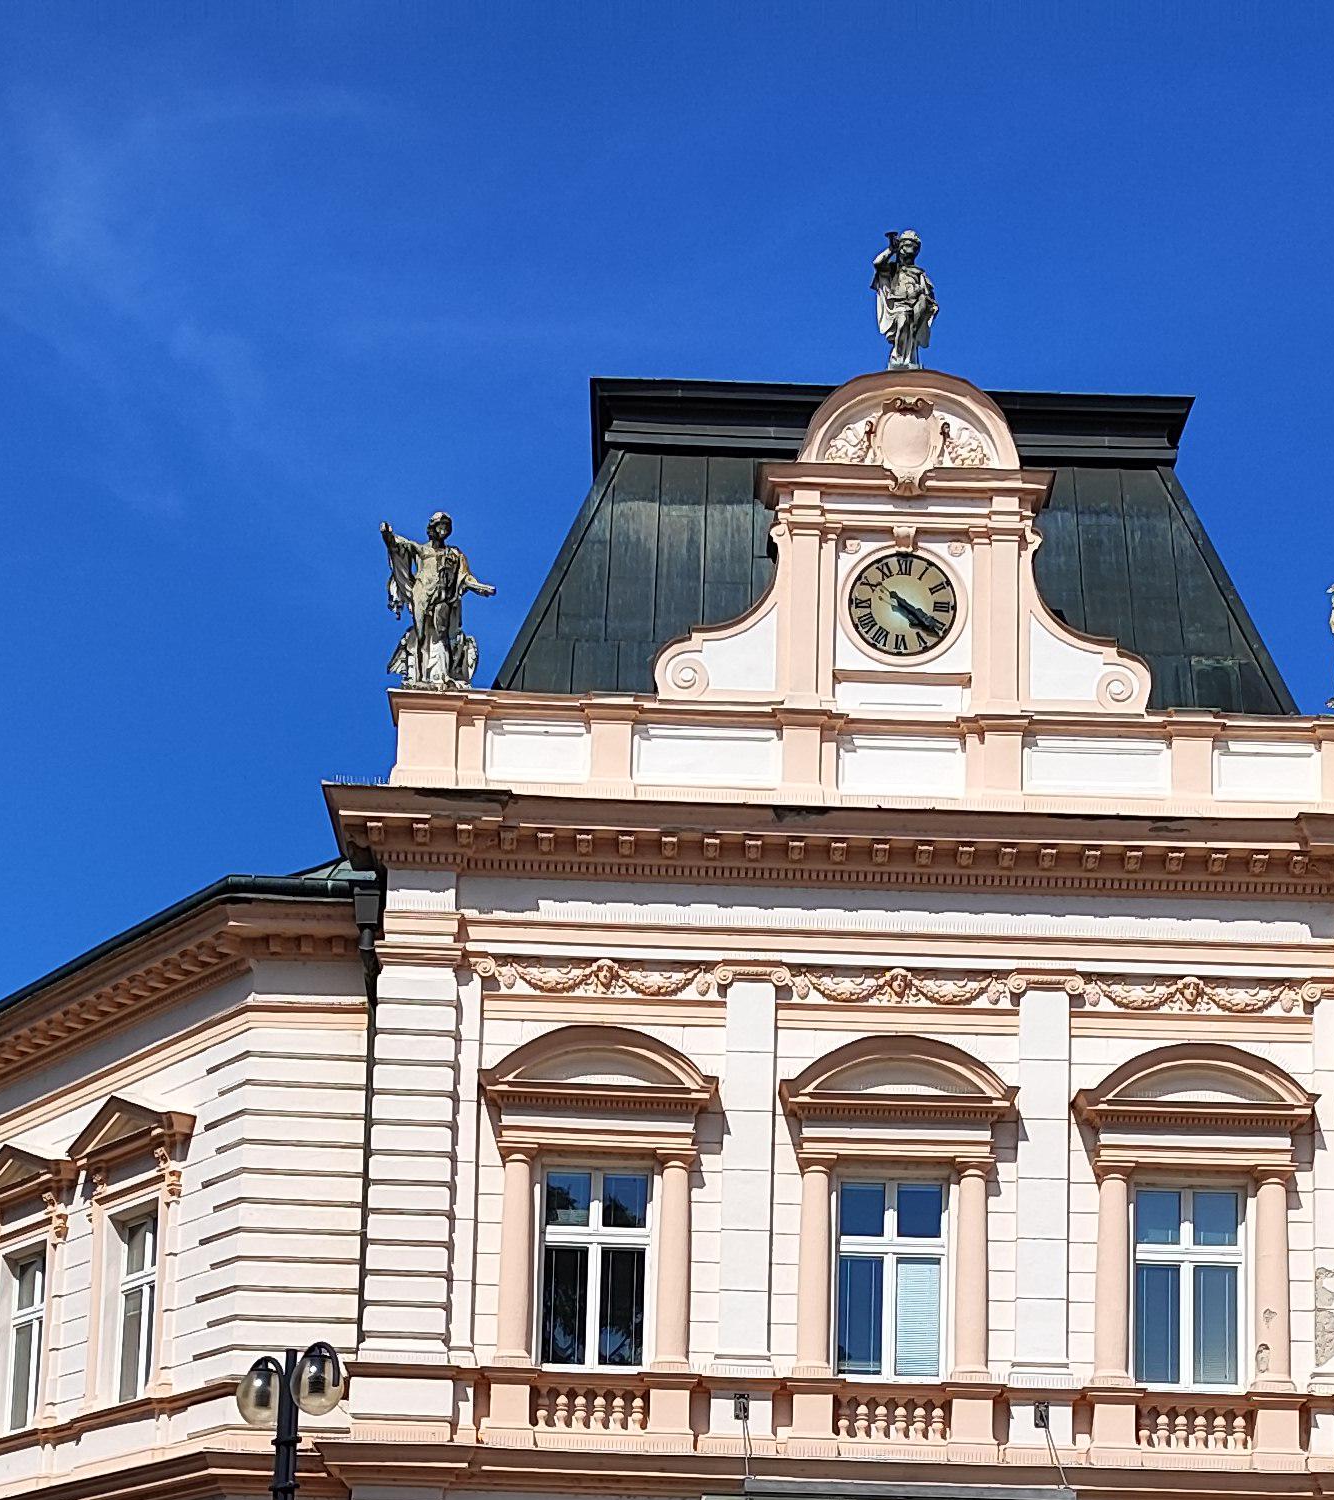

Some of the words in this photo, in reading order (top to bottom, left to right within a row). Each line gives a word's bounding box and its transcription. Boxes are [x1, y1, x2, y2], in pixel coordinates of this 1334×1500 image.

[875, 562, 894, 581] XI
[895, 558, 913, 576] XII
[917, 566, 929, 581] I
[860, 576, 882, 593] X
[928, 581, 947, 595] II
[854, 598, 872, 609] IX
[933, 601, 950, 613] III
[893, 633, 909, 650] VI
[915, 631, 928, 647] V
